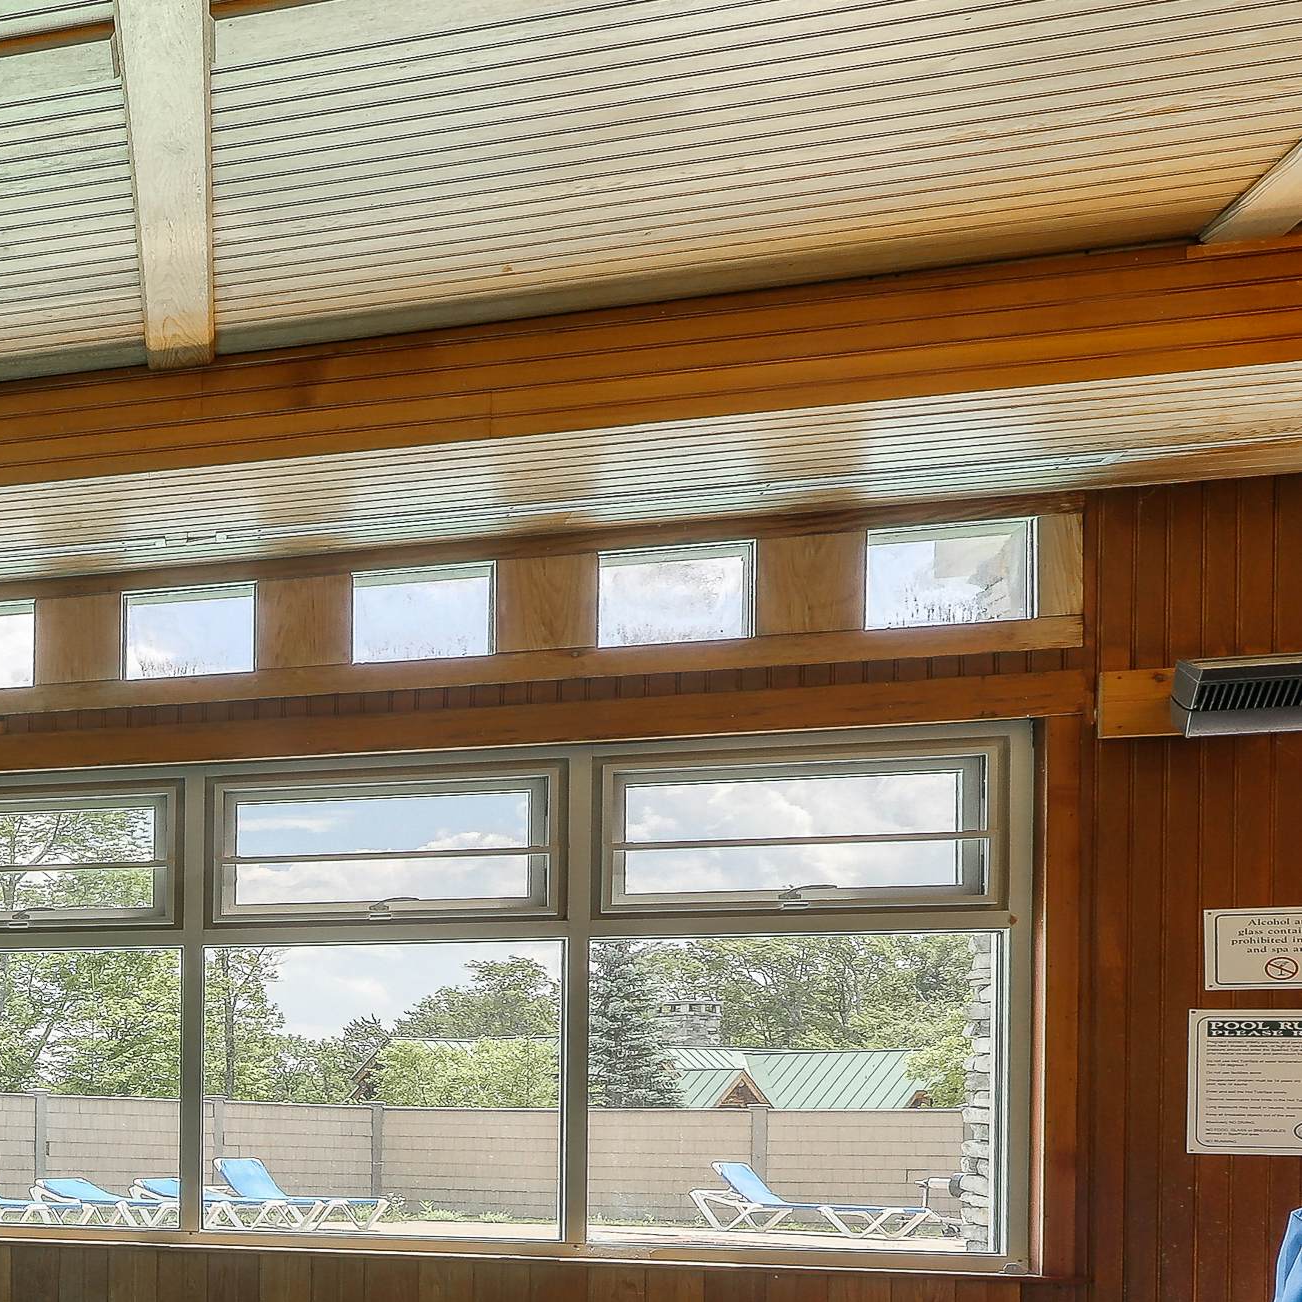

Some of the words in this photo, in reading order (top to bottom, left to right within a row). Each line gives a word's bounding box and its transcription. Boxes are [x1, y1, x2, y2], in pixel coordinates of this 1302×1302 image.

[1248, 918, 1290, 926] Alcohol
[1238, 927, 1263, 936] glass
[1231, 936, 1288, 945] prohibited
[1209, 1021, 1270, 1030] POOL
